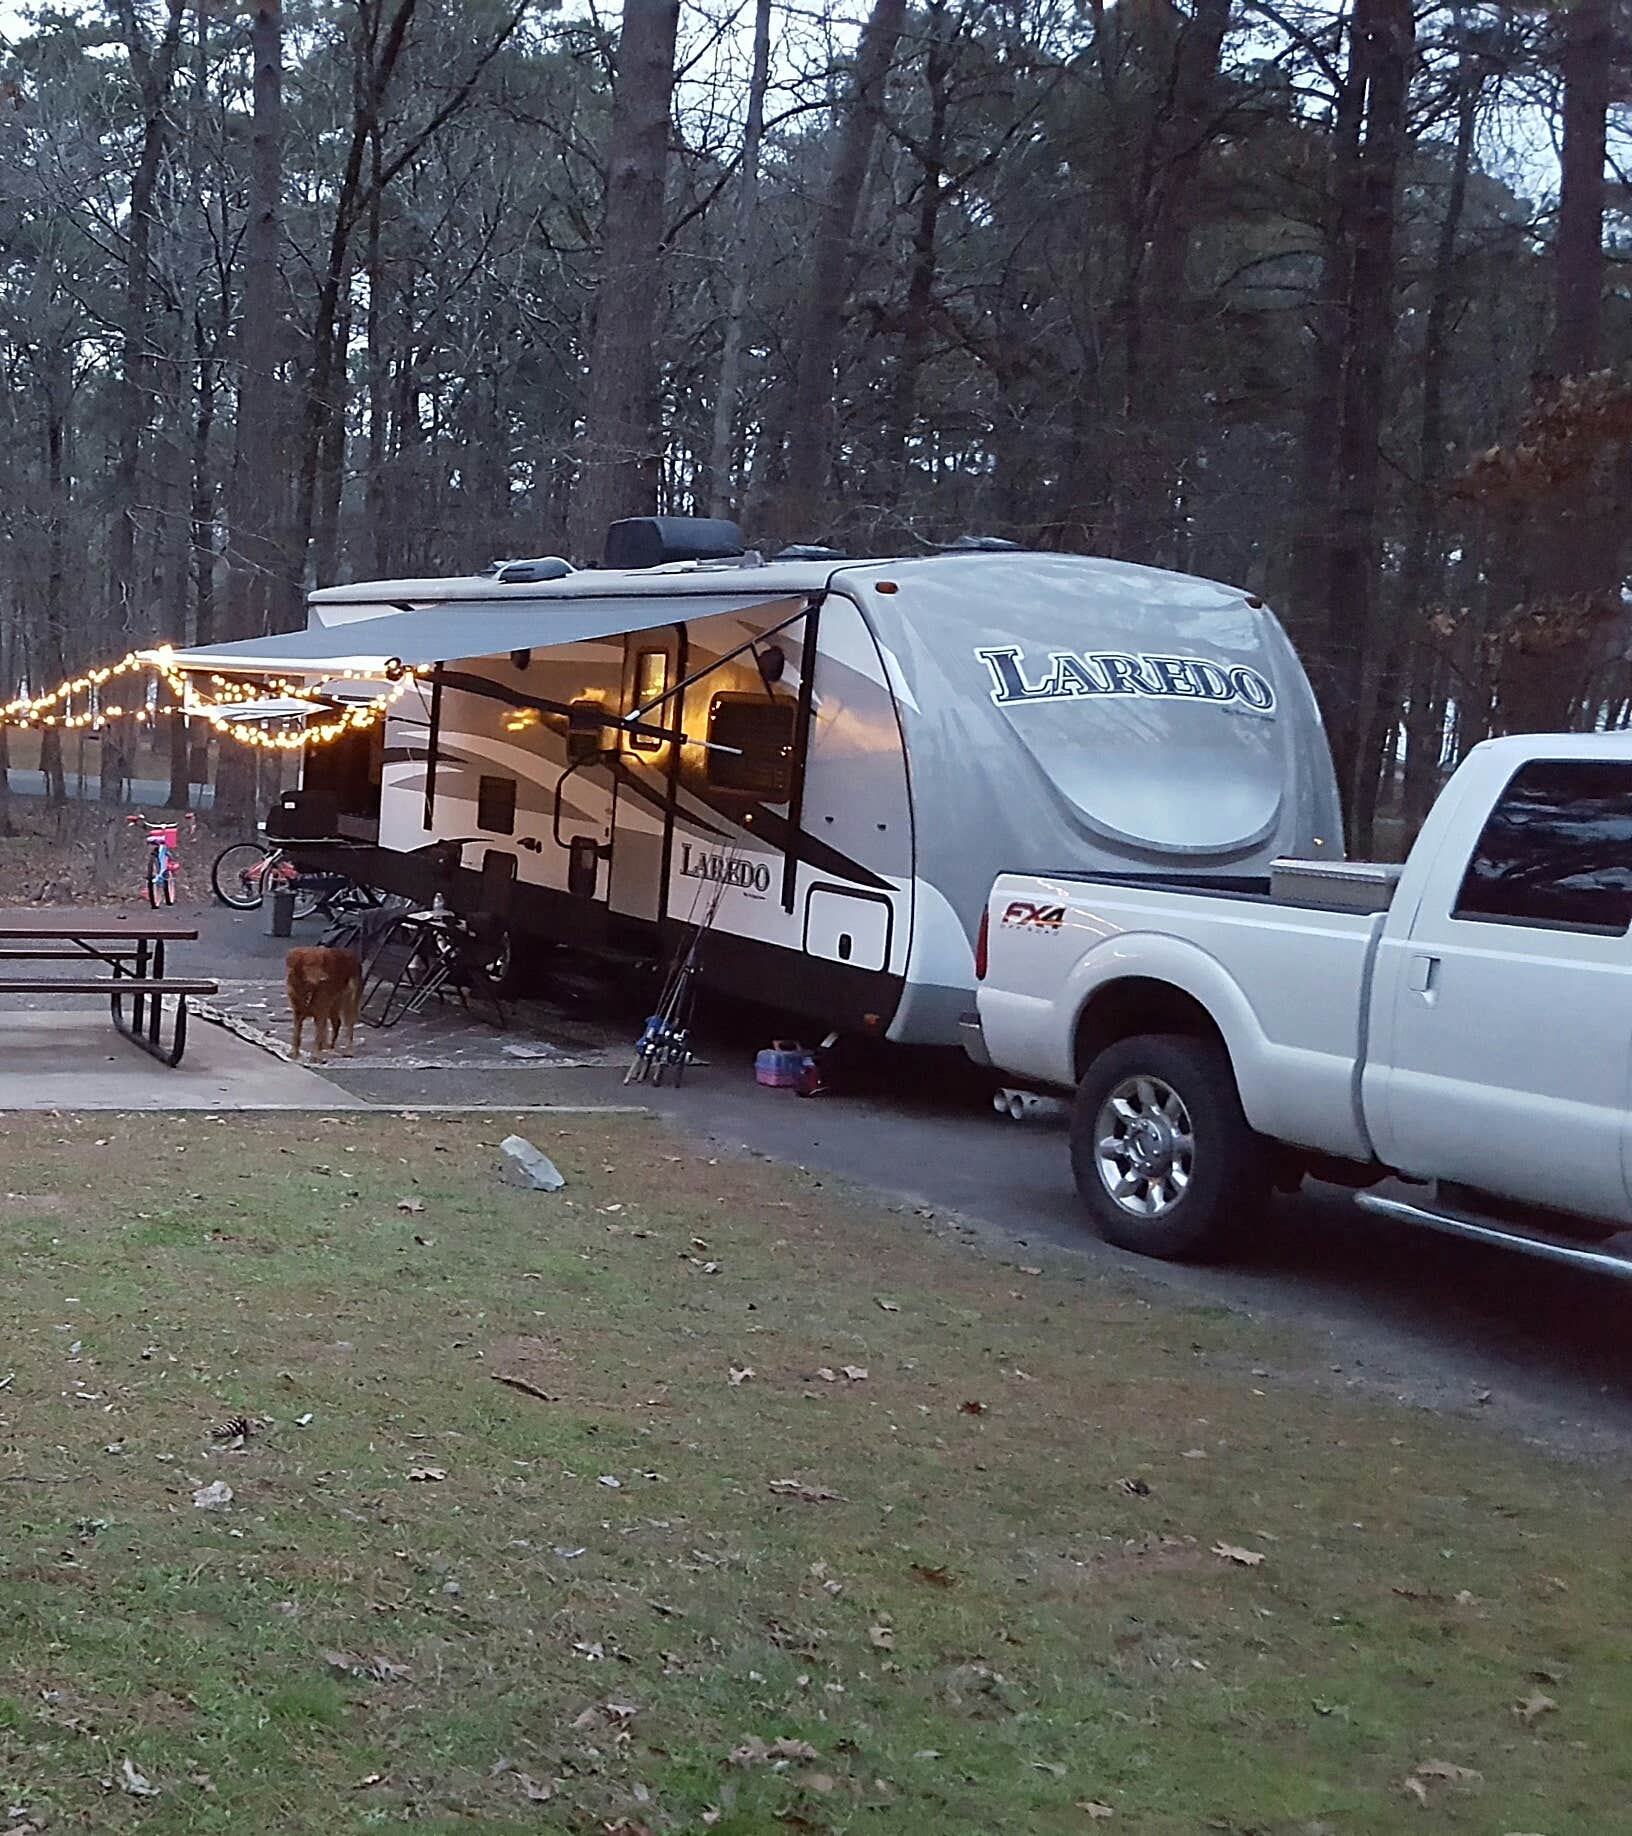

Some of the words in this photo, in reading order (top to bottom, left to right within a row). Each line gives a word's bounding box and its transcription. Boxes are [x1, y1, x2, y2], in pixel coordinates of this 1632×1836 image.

[976, 646, 1275, 712] LAREDO
[680, 842, 770, 892] LAREDO
[1002, 901, 1066, 929] FX4
